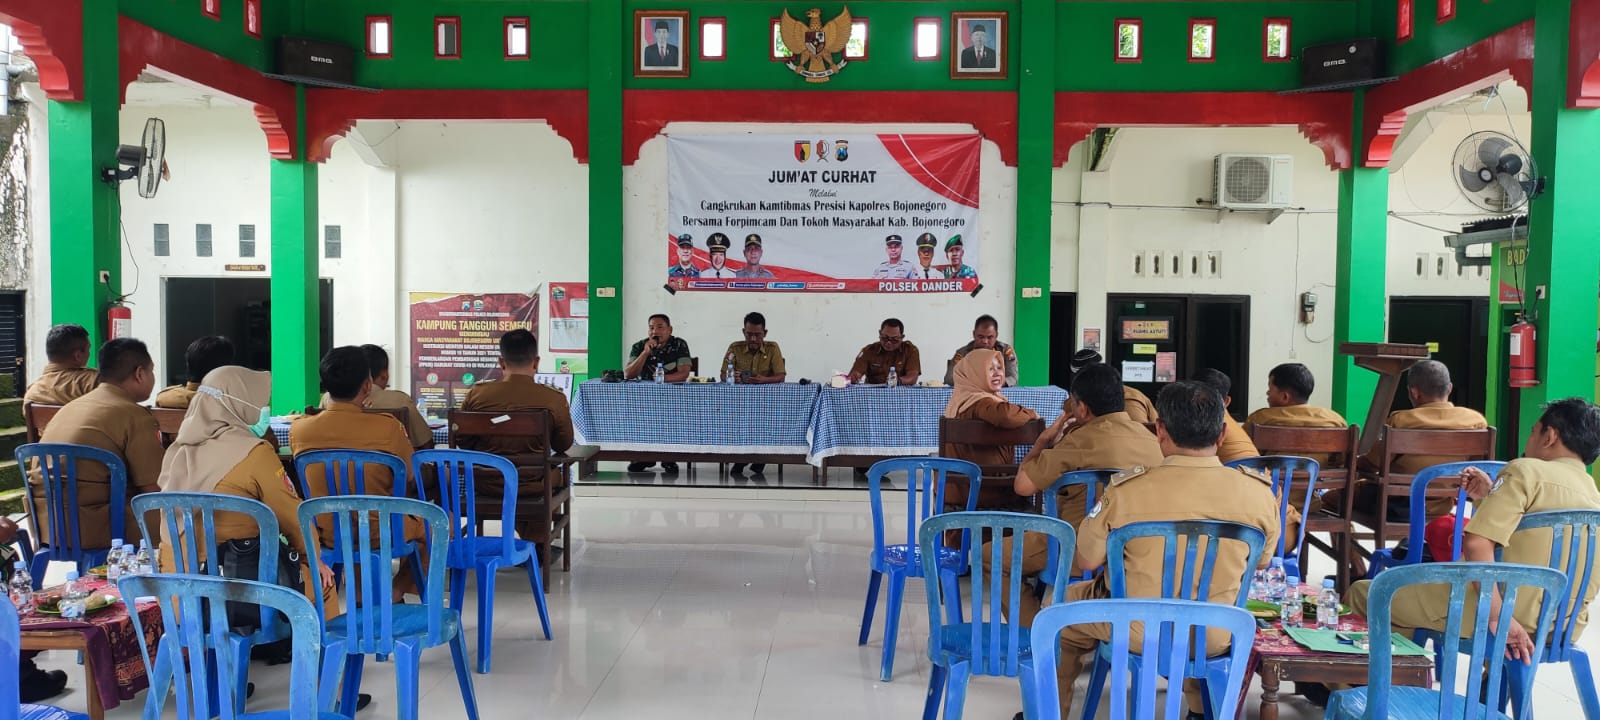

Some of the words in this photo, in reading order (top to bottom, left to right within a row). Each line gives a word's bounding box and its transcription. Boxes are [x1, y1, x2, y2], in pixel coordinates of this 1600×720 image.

[768, 170, 818, 183] JUM'AT
[821, 170, 877, 183] CURHAT
[808, 188, 837, 198] Melalui
[700, 200, 757, 213] Cangkrukan
[759, 200, 812, 211] Kamtibmas
[814, 200, 846, 211] Presisi
[849, 200, 890, 213] Kapolres
[893, 200, 947, 213] Bojonegoro
[682, 215, 722, 227] Bersama
[725, 216, 777, 229] Forpimcam
[780, 216, 798, 227] Dan
[801, 216, 829, 227] Tokoh
[832, 216, 885, 229] Masyarakat
[888, 216, 909, 227] Kab.
[912, 216, 965, 229] Bojonegoro
[879, 281, 918, 292] POLSEK
[921, 281, 963, 291] DANDER
[416, 320, 457, 331] KAMPUNG
[459, 321, 497, 331] TANGGUH
